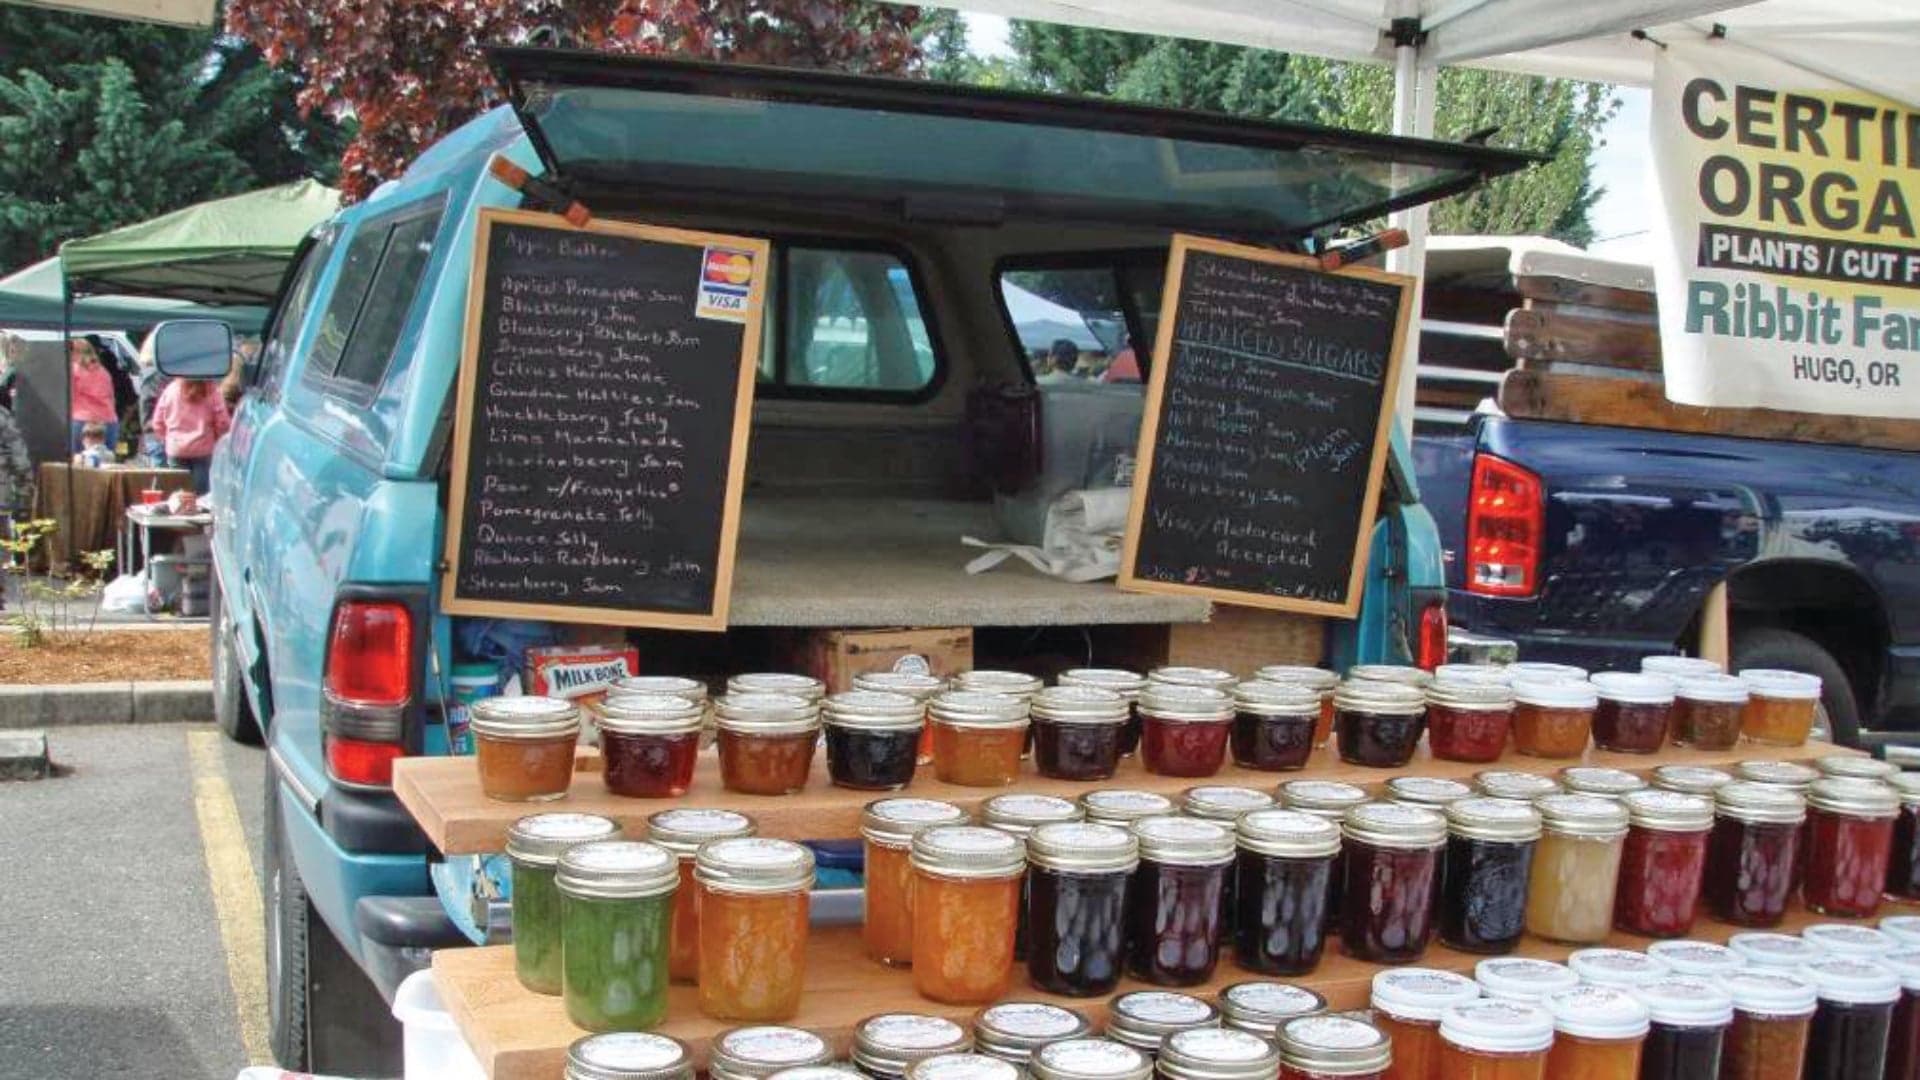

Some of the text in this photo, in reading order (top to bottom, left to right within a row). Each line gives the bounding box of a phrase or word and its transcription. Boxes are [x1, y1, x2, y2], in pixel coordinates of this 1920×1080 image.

[1699, 154, 1916, 239] ORGA
[1712, 233, 1821, 273] PLANTS
[1842, 248, 1899, 282] CUT
[709, 294, 742, 309] VISA
[1684, 279, 1843, 345] Ribbit
[610, 346, 652, 364] Jam
[1178, 318, 1384, 379] REDUCED SUGARS
[491, 358, 559, 379] Citrus
[1793, 354, 1900, 390] HUGO, OR
[662, 393, 701, 411] Jam
[485, 403, 609, 435] Huckleberry
[489, 427, 684, 448] Lime Marmalade
[639, 453, 684, 469] Jam
[479, 499, 655, 531] Pomegranate Jelly
[477, 523, 599, 558] Quince Jelly
[580, 575, 625, 593] Jam
